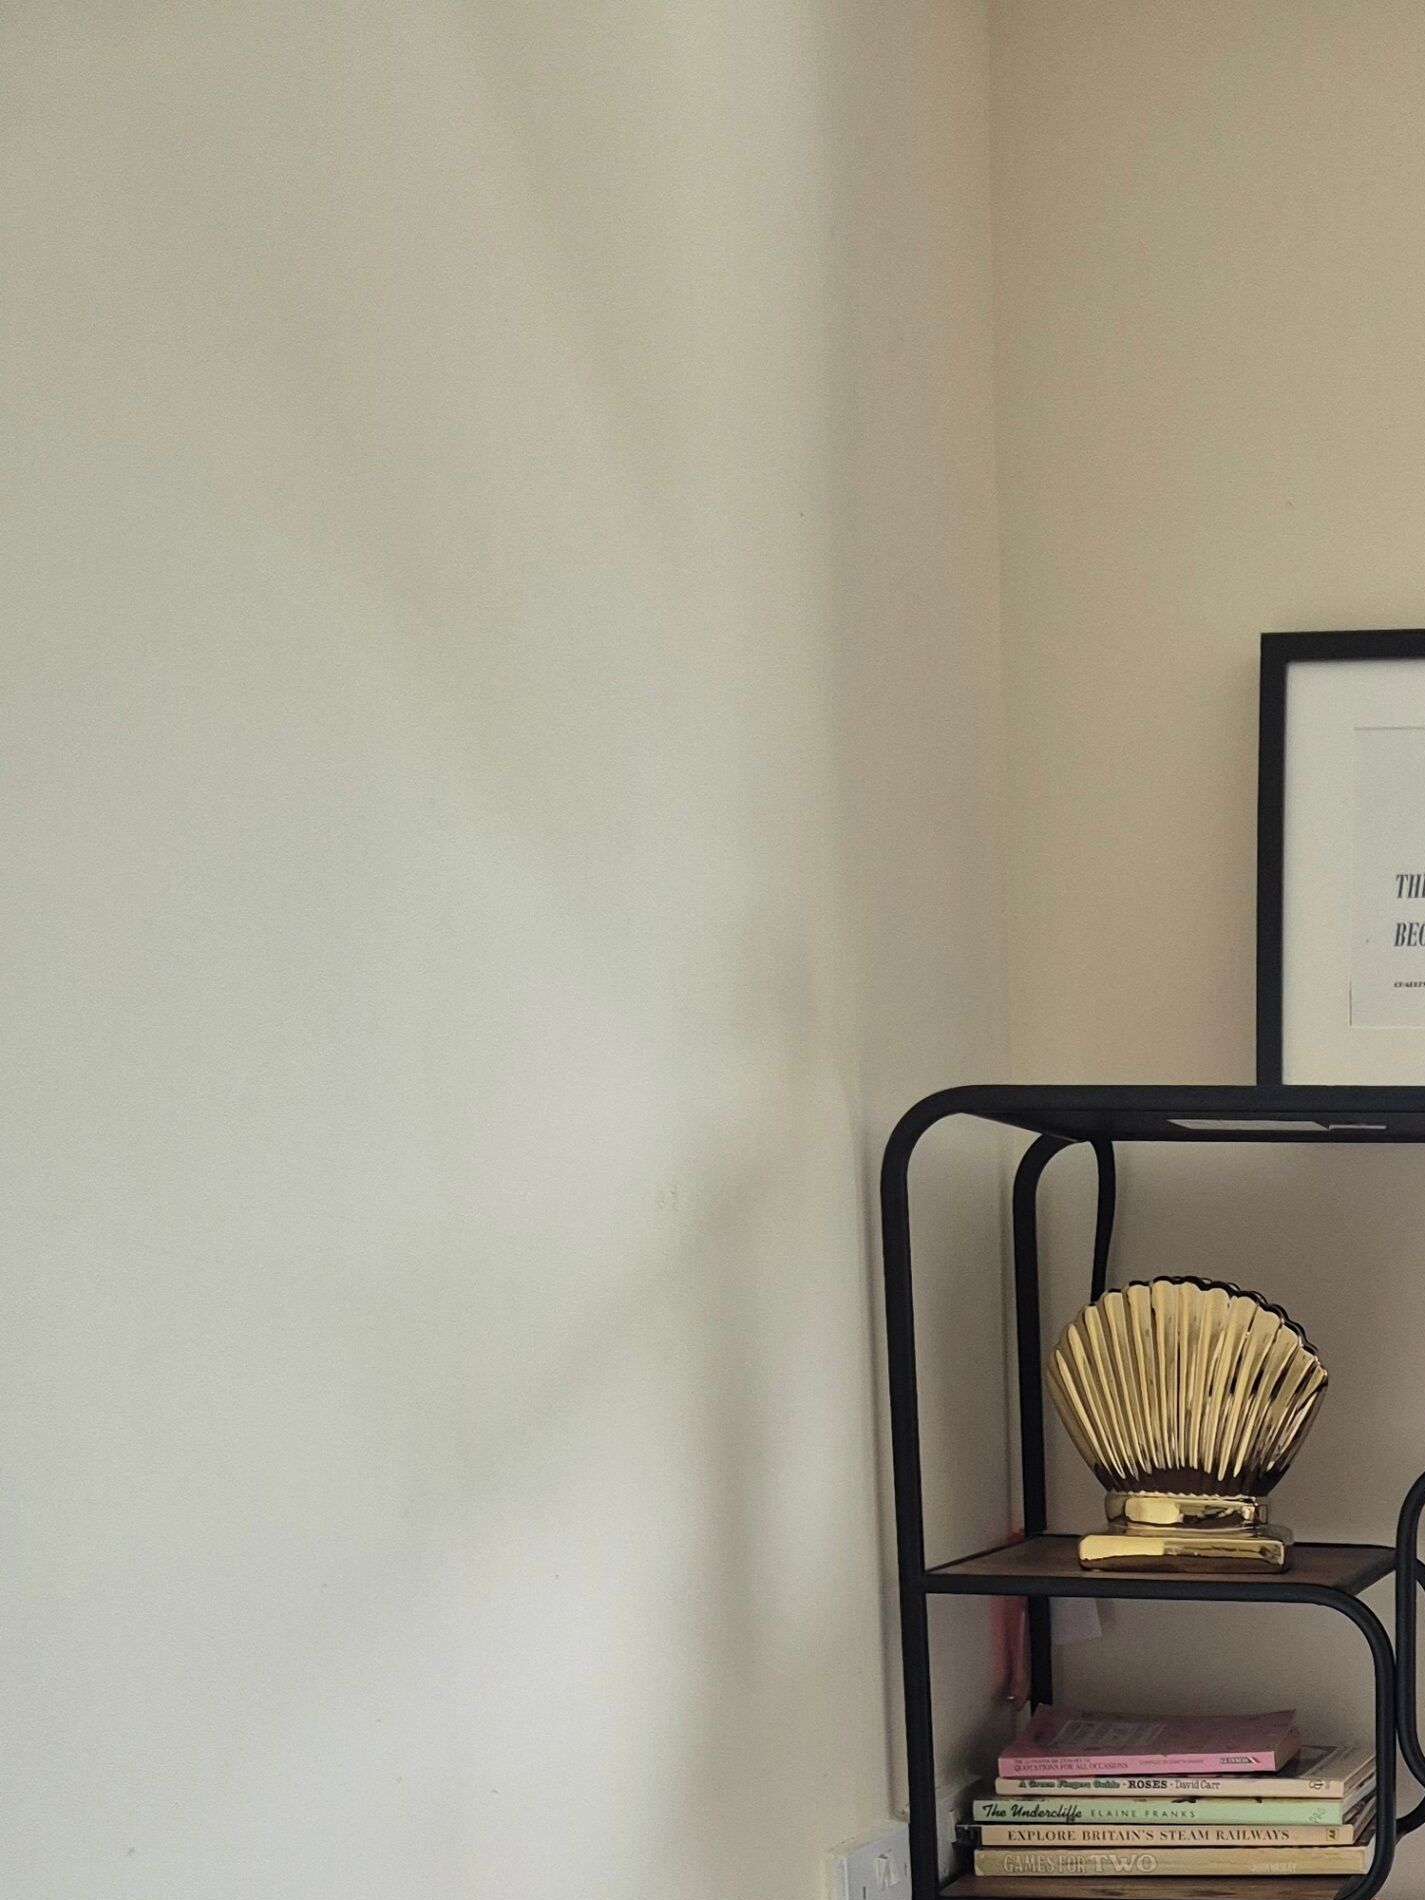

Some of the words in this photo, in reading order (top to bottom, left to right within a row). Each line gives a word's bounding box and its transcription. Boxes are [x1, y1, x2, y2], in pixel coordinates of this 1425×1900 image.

[1127, 1780, 1168, 1789] ROSES
[1175, 1780, 1199, 1789] David
[1200, 1780, 1220, 1789] Carr
[982, 1804, 1007, 1818] The
[1010, 1804, 1083, 1822] Undercliffe
[1091, 1809, 1136, 1818] ELAINE
[1145, 1809, 1196, 1818] FRANKS
[1008, 1830, 1076, 1841] EXPLORE
[1082, 1830, 1154, 1841] BRITAIN'S
[1160, 1829, 1209, 1841] STEAM
[1216, 1829, 1290, 1841] RAILWAYS
[1003, 1854, 1055, 1873] GAMES
[1058, 1854, 1087, 1873] FOR
[1089, 1853, 1158, 1873] TWO
